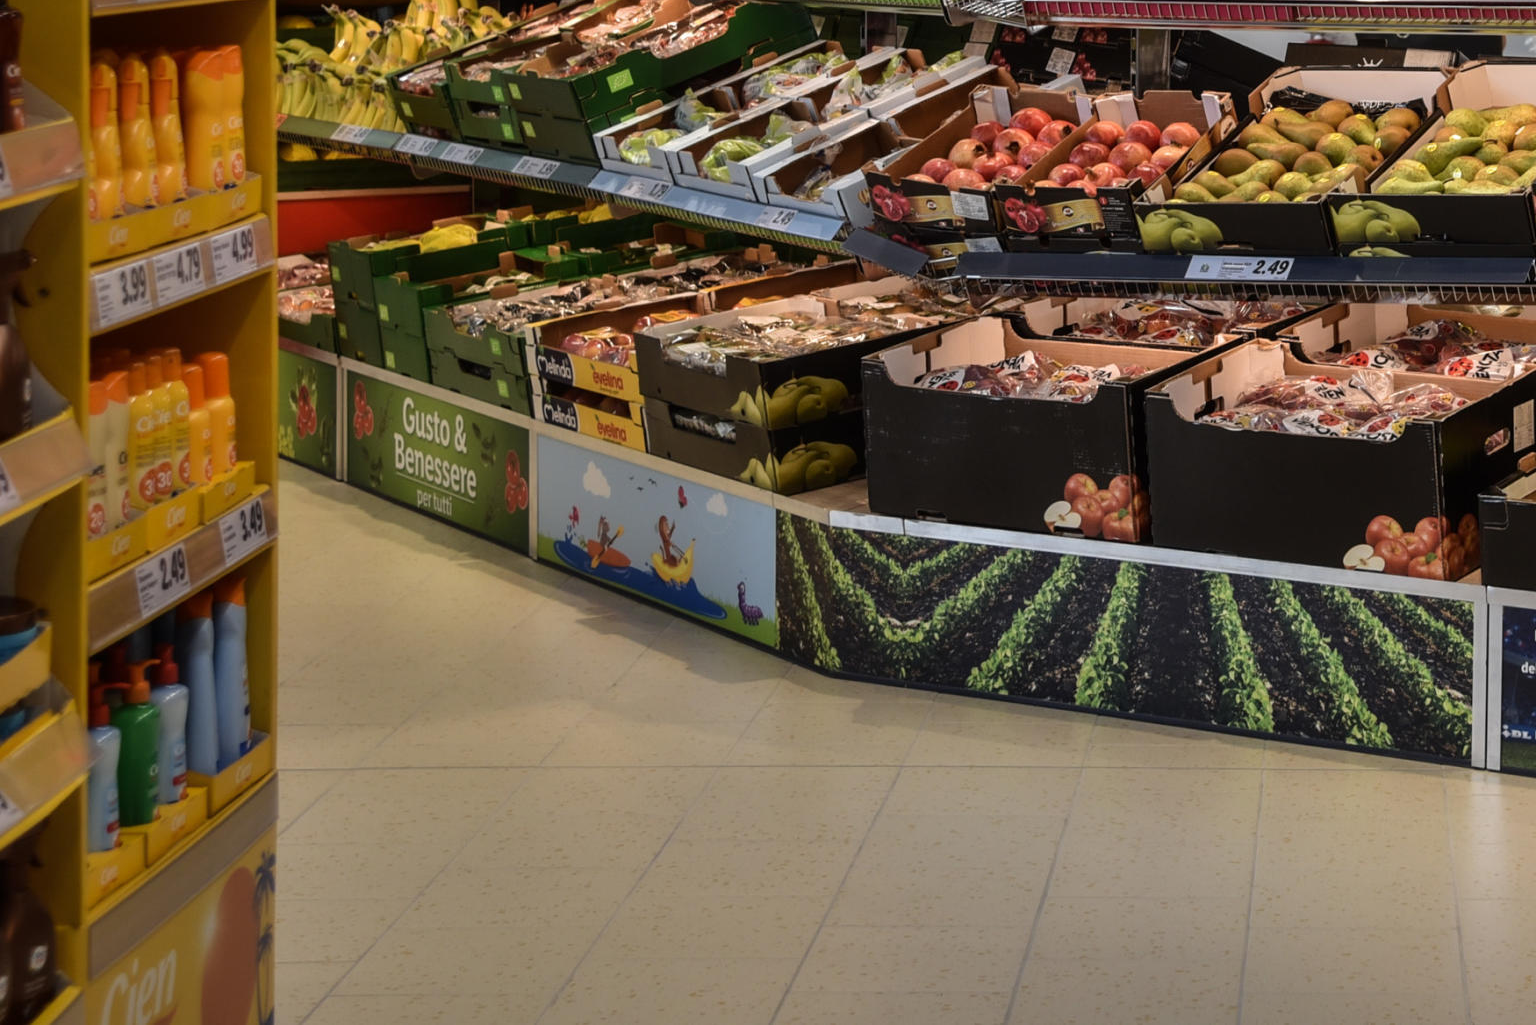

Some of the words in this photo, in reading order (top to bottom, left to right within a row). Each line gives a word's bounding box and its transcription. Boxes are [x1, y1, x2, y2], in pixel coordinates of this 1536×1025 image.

[231, 228, 254, 264] 4.99
[176, 246, 201, 284] 4.79
[1253, 260, 1289, 275] 2.49
[120, 263, 146, 306] 3.99
[537, 355, 572, 379] Melinda
[592, 371, 624, 391] evelina
[403, 397, 450, 447] Gusto
[455, 414, 467, 453] &
[544, 404, 576, 428] Melinda
[597, 422, 627, 442] evelina
[394, 432, 476, 498] Benessere
[240, 499, 263, 542] 3.49
[416, 490, 431, 508] per
[433, 493, 452, 516] tutti
[160, 546, 186, 591] 2.49
[101, 948, 177, 1025] Cien
